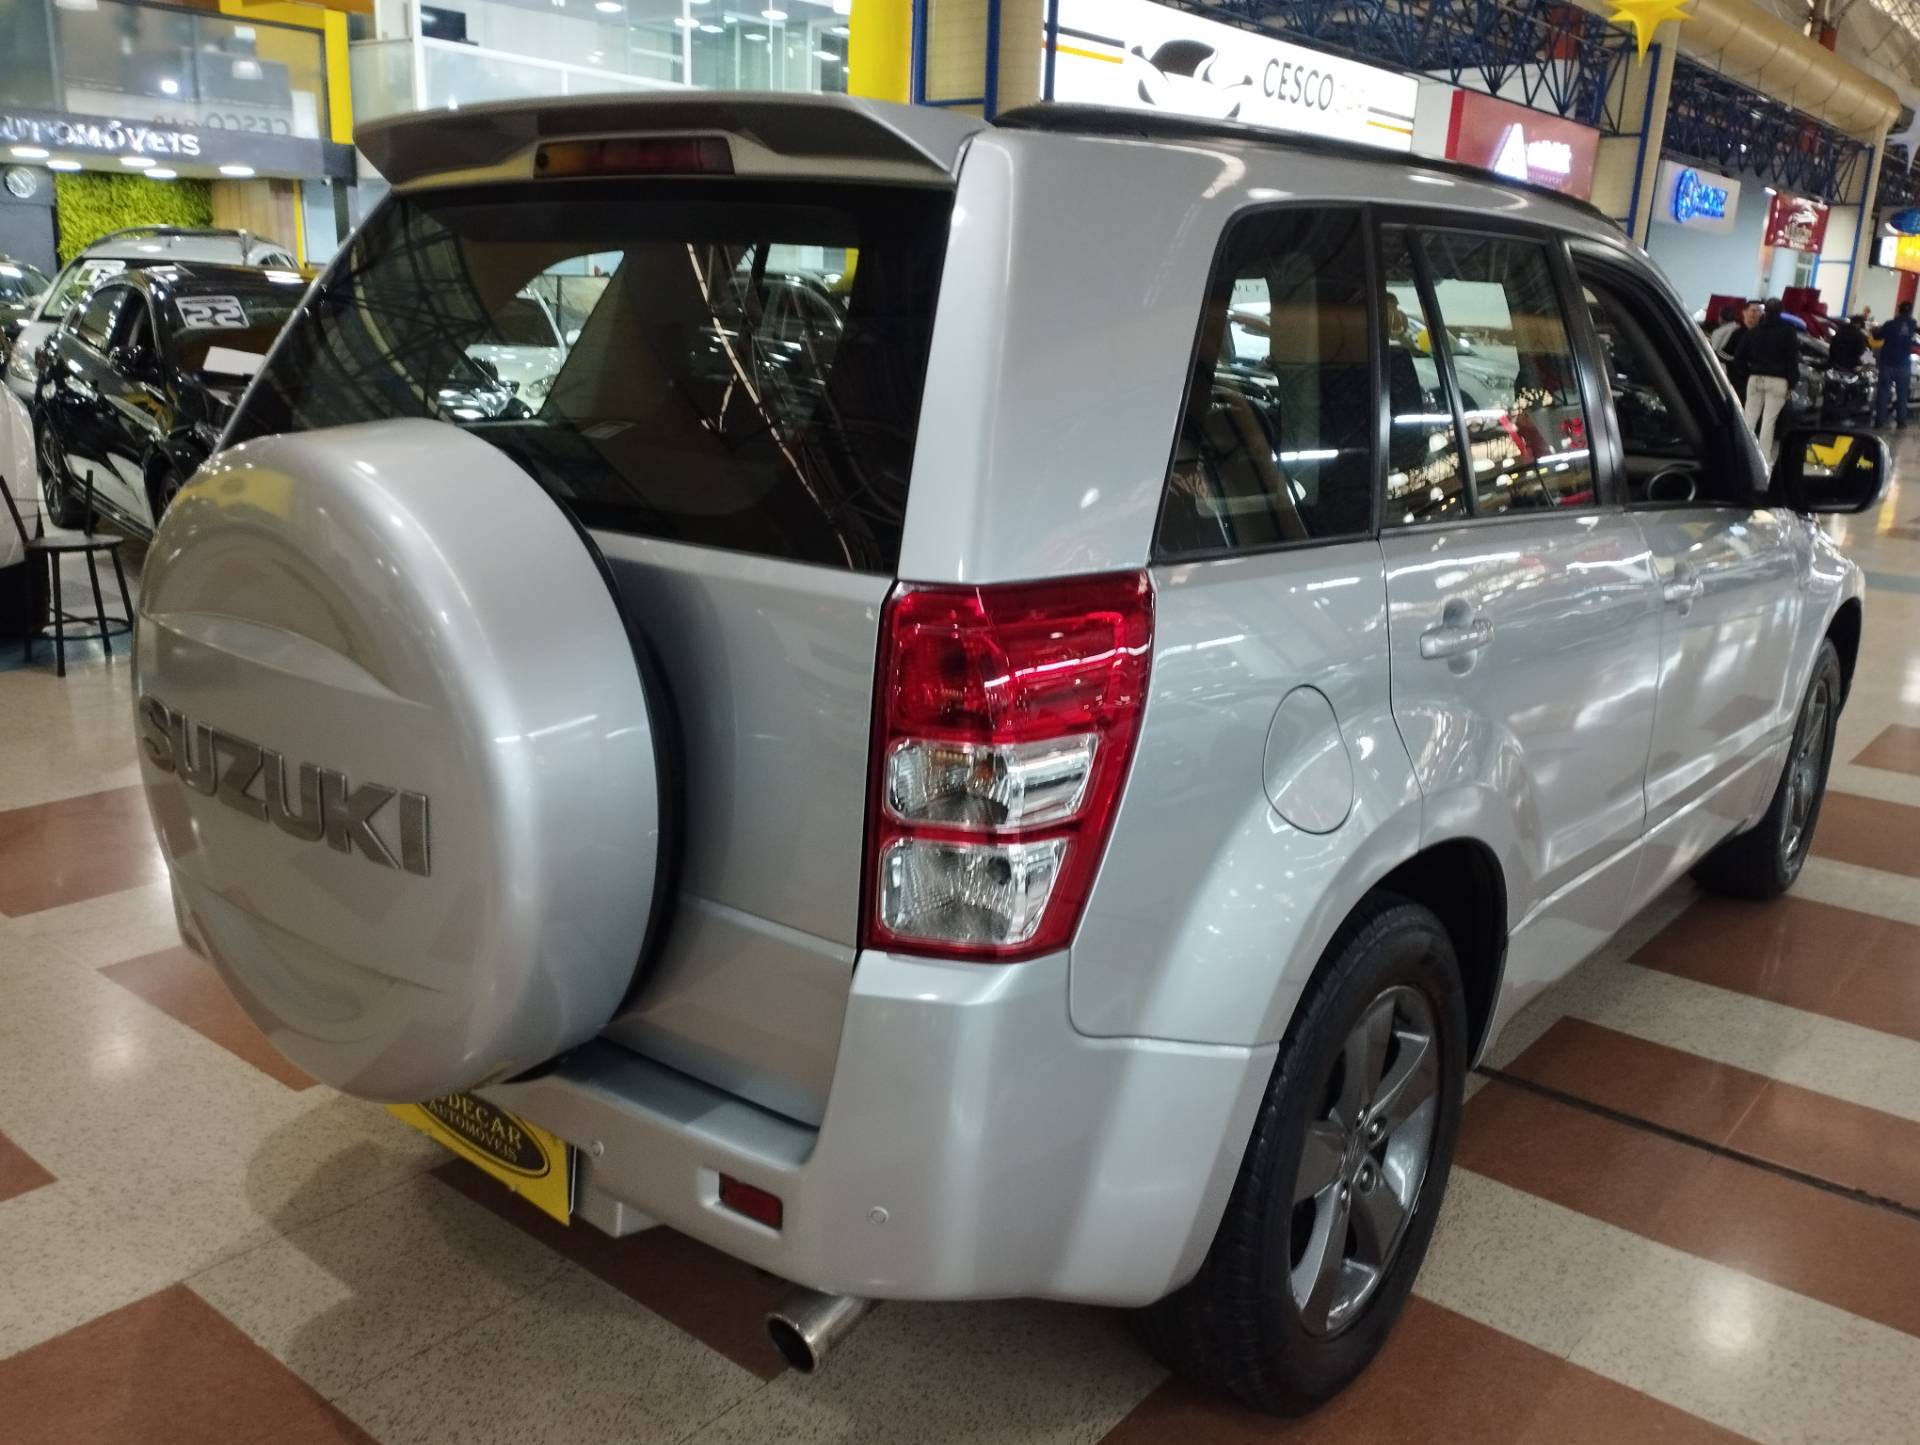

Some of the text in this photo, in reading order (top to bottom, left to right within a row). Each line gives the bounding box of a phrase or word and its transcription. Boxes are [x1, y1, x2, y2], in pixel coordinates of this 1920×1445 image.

[1264, 58, 1334, 111] CESCO
[0, 117, 201, 156] UTOMÓVEIS
[138, 694, 431, 878] SUZUKI
[441, 1093, 521, 1150] DECAR
